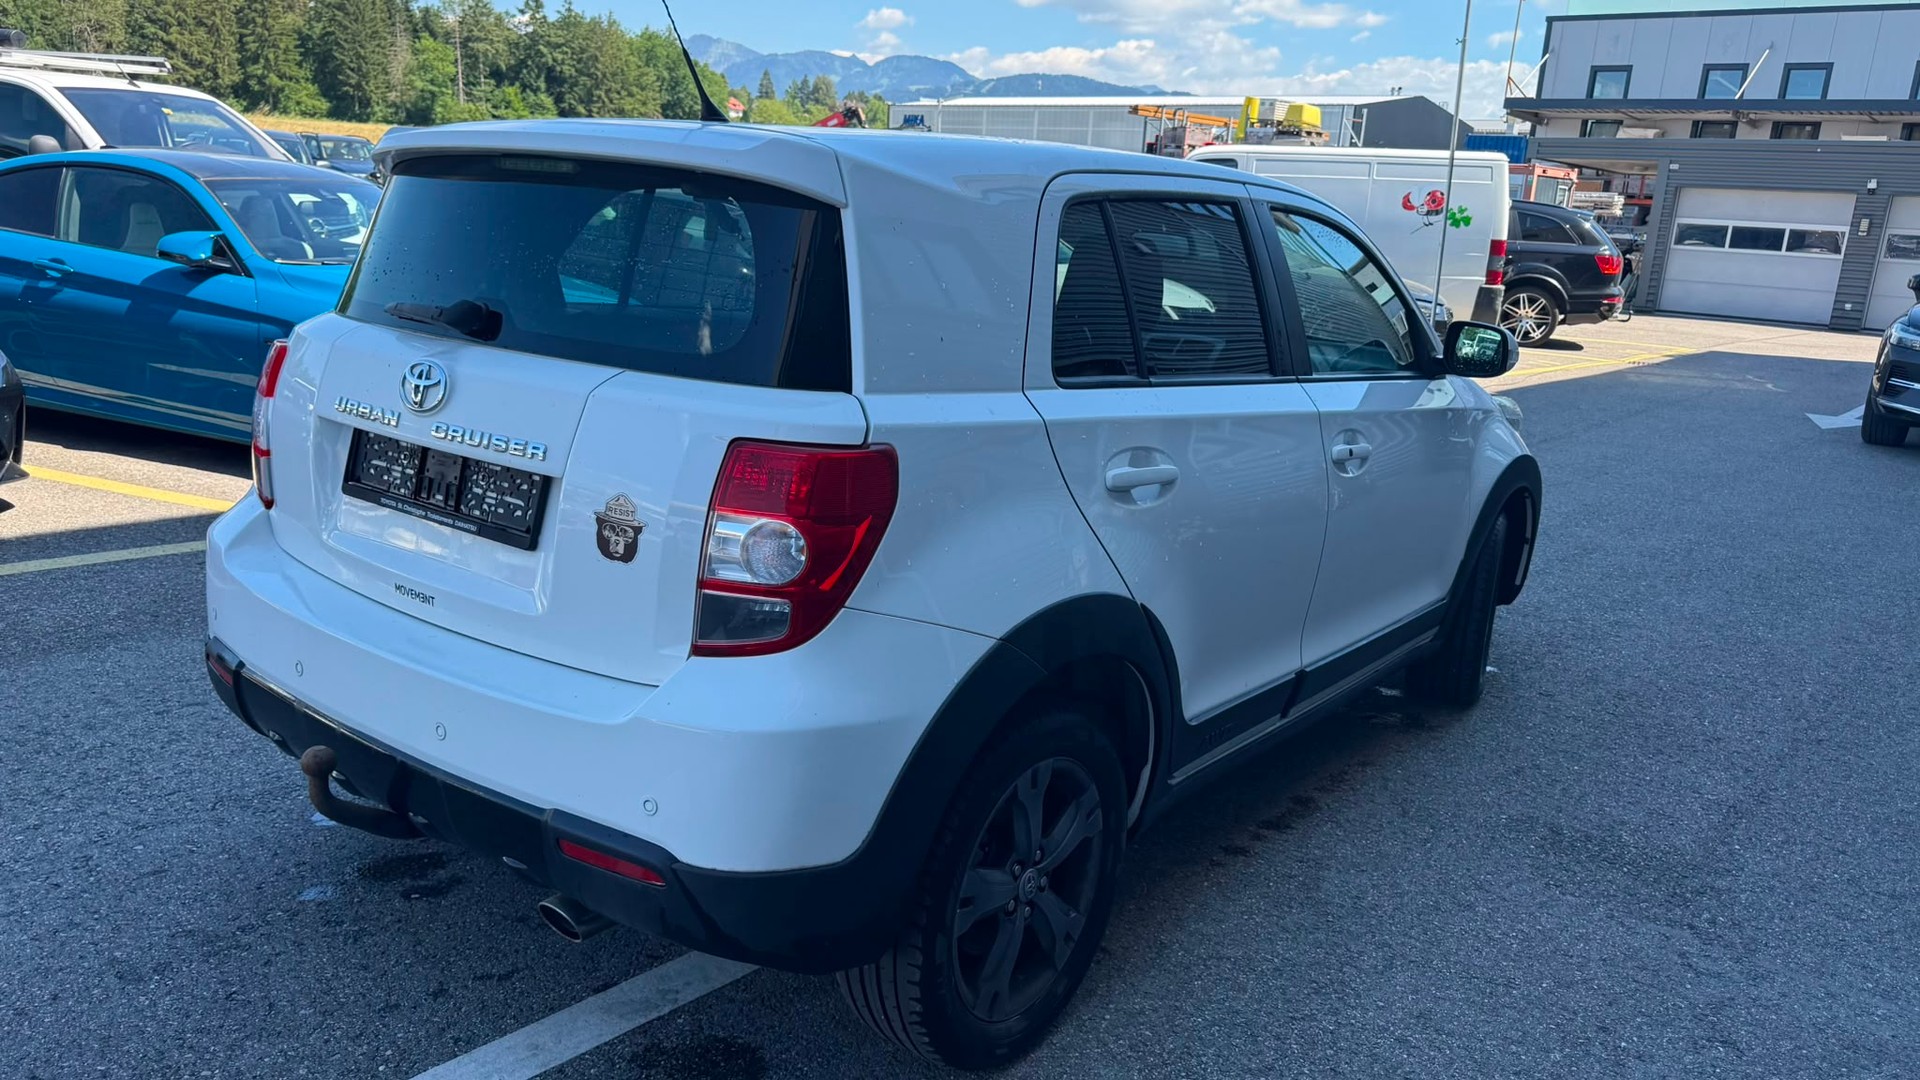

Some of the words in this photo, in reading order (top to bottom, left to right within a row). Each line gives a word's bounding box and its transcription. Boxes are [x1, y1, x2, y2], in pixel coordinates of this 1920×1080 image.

[334, 396, 401, 428] URBAN
[431, 421, 548, 462] CRUISER
[380, 497, 397, 507] TOYOTA
[454, 520, 477, 532] DAIHATSU
[608, 505, 635, 517] RESIST
